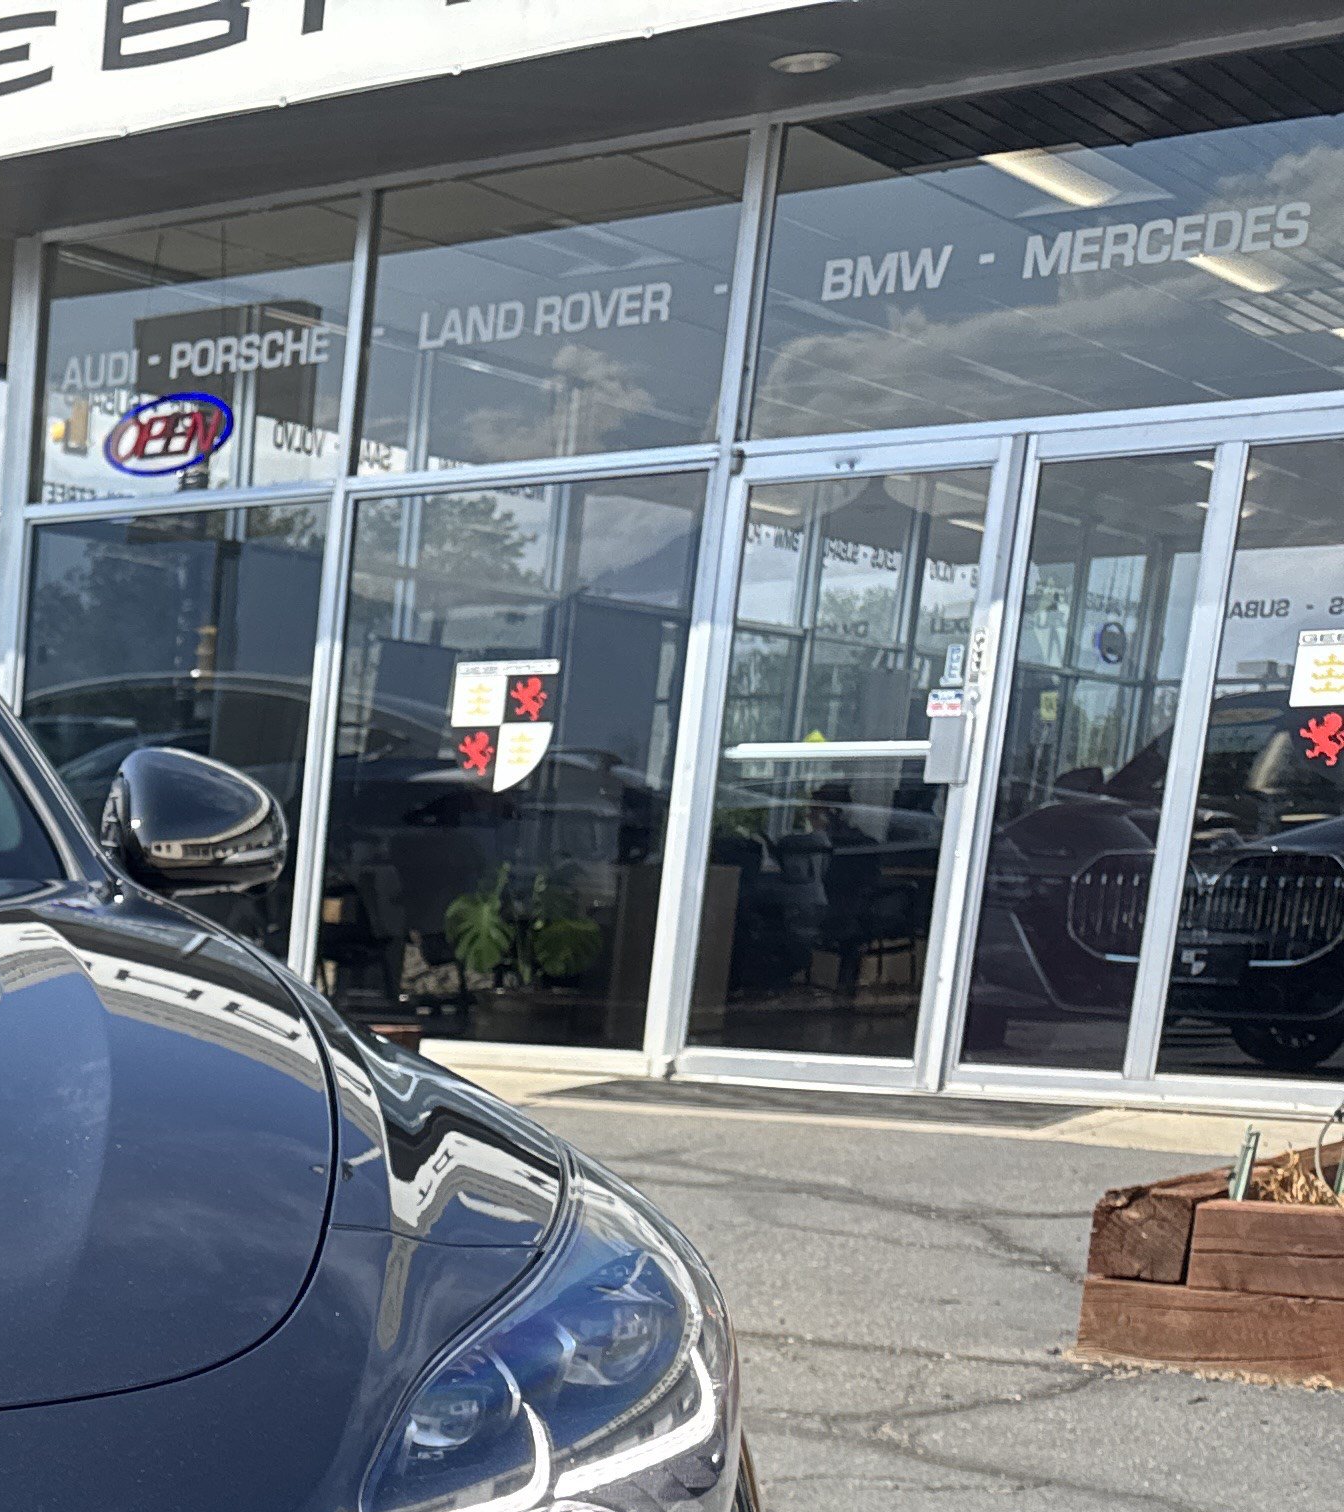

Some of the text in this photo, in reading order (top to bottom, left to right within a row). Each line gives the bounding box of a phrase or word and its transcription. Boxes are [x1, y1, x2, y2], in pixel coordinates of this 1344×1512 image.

[821, 244, 953, 302] BMW
[1022, 200, 1312, 279] MERCEDES
[417, 299, 525, 350] LAND
[533, 281, 673, 337] ROVER
[63, 348, 139, 391] AUDI
[169, 326, 331, 380] PORSCHE
[112, 407, 223, 463] OPEN
